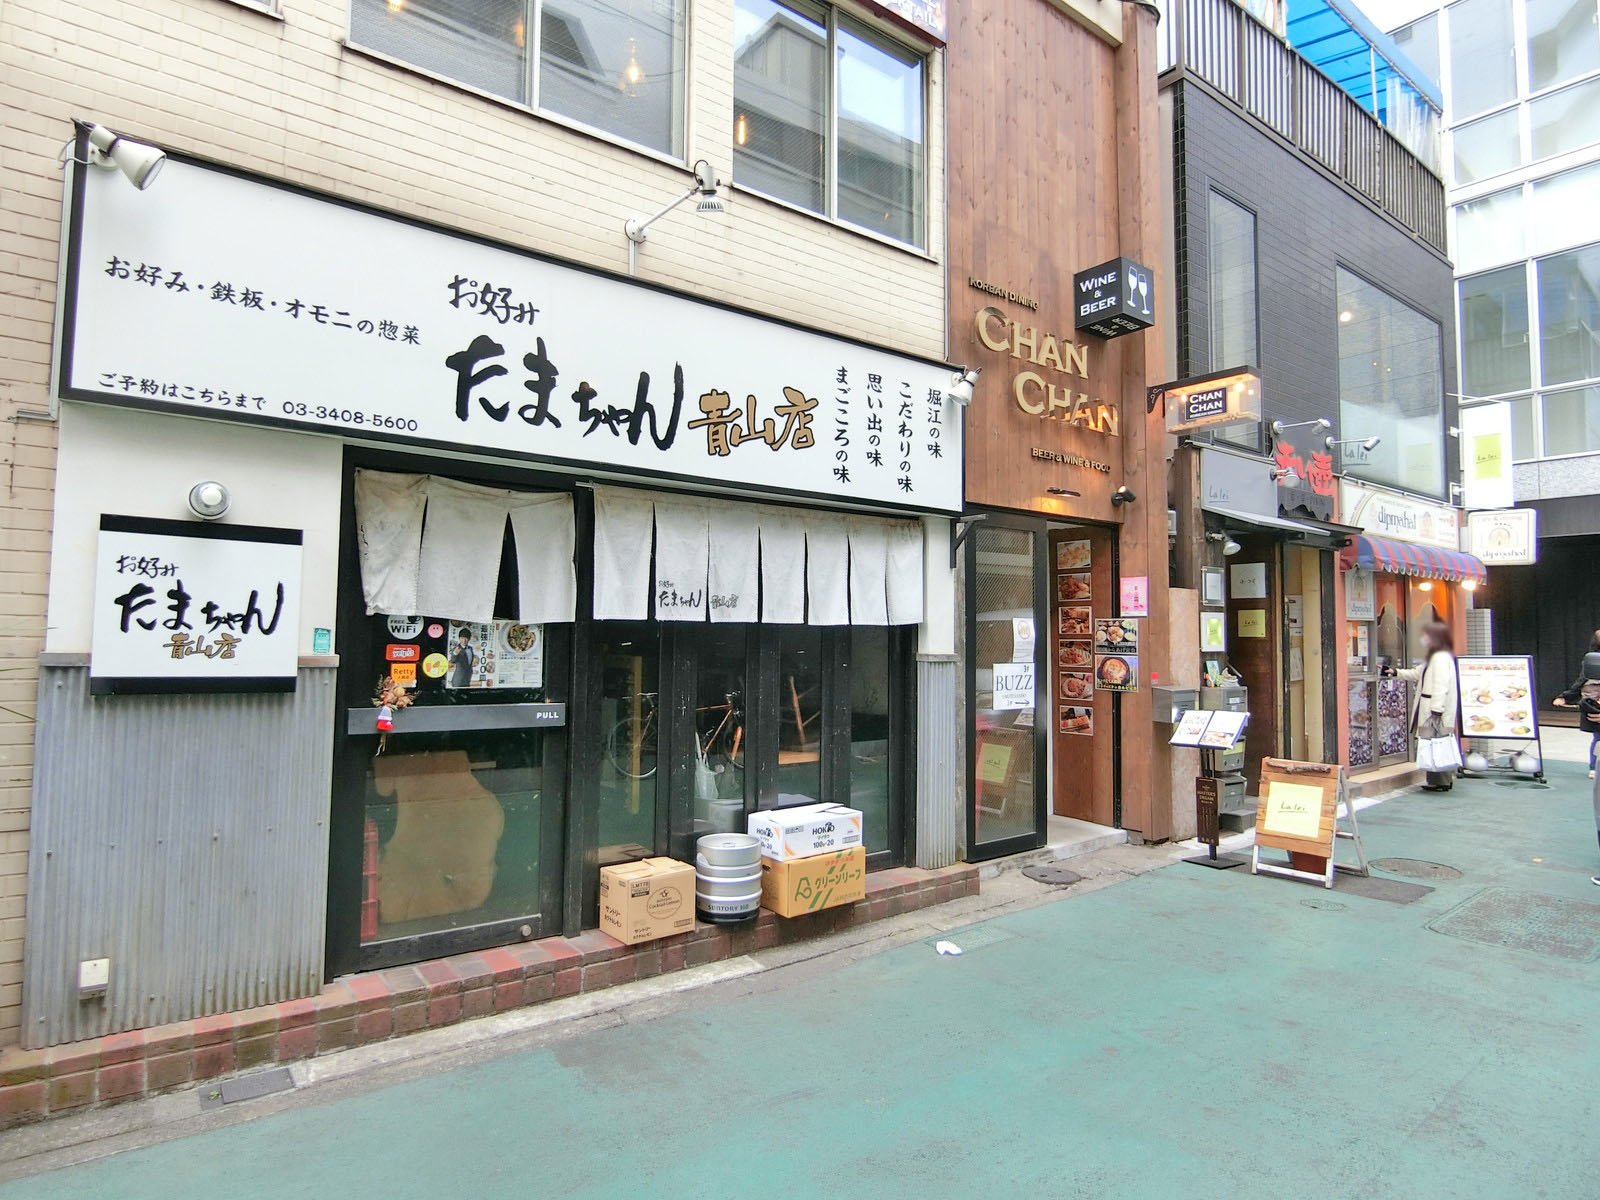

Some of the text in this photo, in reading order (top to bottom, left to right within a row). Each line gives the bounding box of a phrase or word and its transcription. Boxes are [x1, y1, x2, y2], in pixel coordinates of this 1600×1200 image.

[968, 277, 1040, 311] KOREAN DINING
[1080, 271, 1117, 294] WINE
[1093, 290, 1102, 299] &
[103, 255, 422, 346] お好み・鉄板・オモニの惣菜
[447, 273, 540, 325] お好み
[1080, 295, 1117, 317] BEER
[975, 306, 1089, 379] CHAN
[98, 371, 419, 432] ご予約はこちらまで 03-3408-5600
[444, 333, 820, 457] たまちゃん 青山店
[1014, 371, 1119, 437] CHAN
[1189, 390, 1222, 404] CHAN
[1189, 400, 1222, 414] CHAN
[832, 365, 851, 484] まごころの味
[866, 372, 883, 467] 思い出の味
[926, 387, 943, 459] 堀江の味
[897, 381, 914, 493] こだわりの味
[1031, 447, 1111, 473] BEER & WINE & FOOD
[115, 554, 180, 579] お好み
[113, 578, 285, 636] たまちゃん
[658, 588, 702, 608] たまちゃん
[390, 625, 417, 634] WiFi
[162, 632, 243, 660] 青山店
[393, 668, 414, 676] Retty
[995, 674, 1033, 692] BUZZ
[536, 711, 559, 719] PULL
